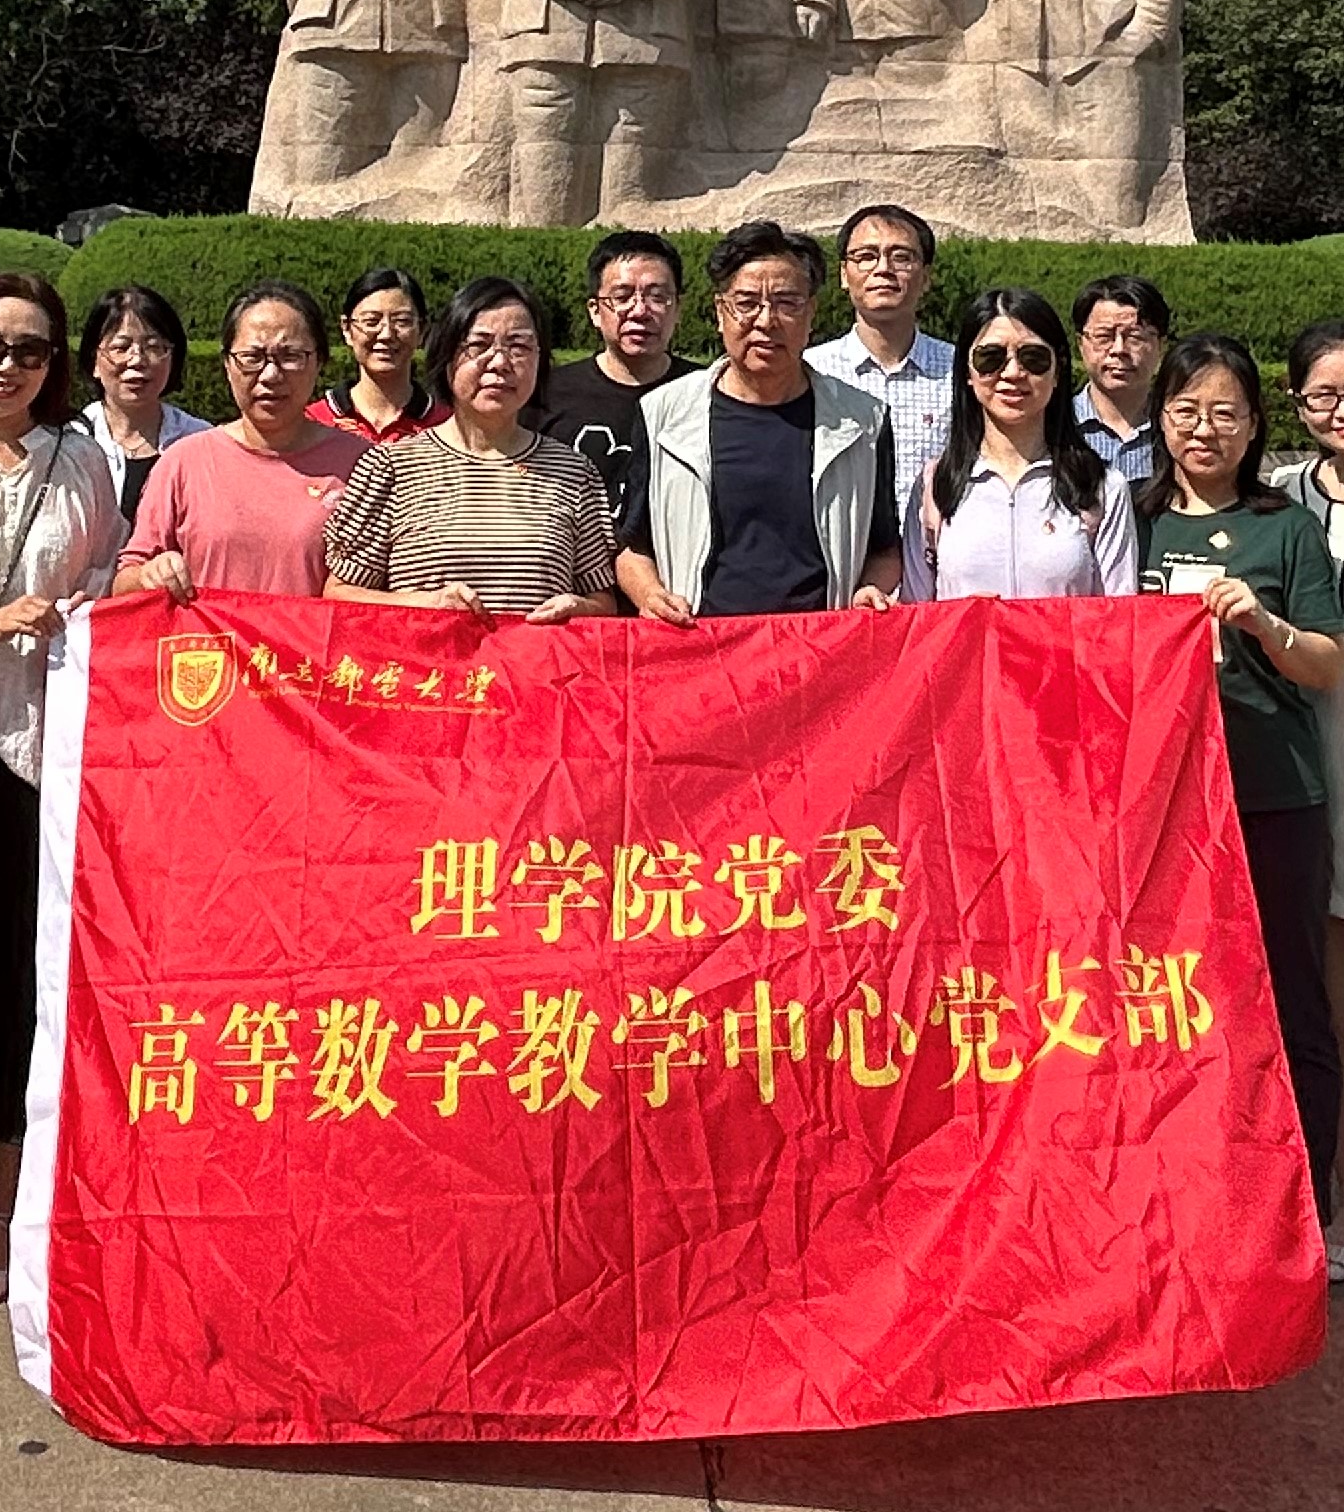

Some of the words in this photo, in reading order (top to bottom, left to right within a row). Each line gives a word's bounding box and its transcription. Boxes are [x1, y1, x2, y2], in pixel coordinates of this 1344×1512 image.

[410, 824, 906, 943] 理学院党委
[129, 944, 1214, 1125] 高等数学教学中心党支部
